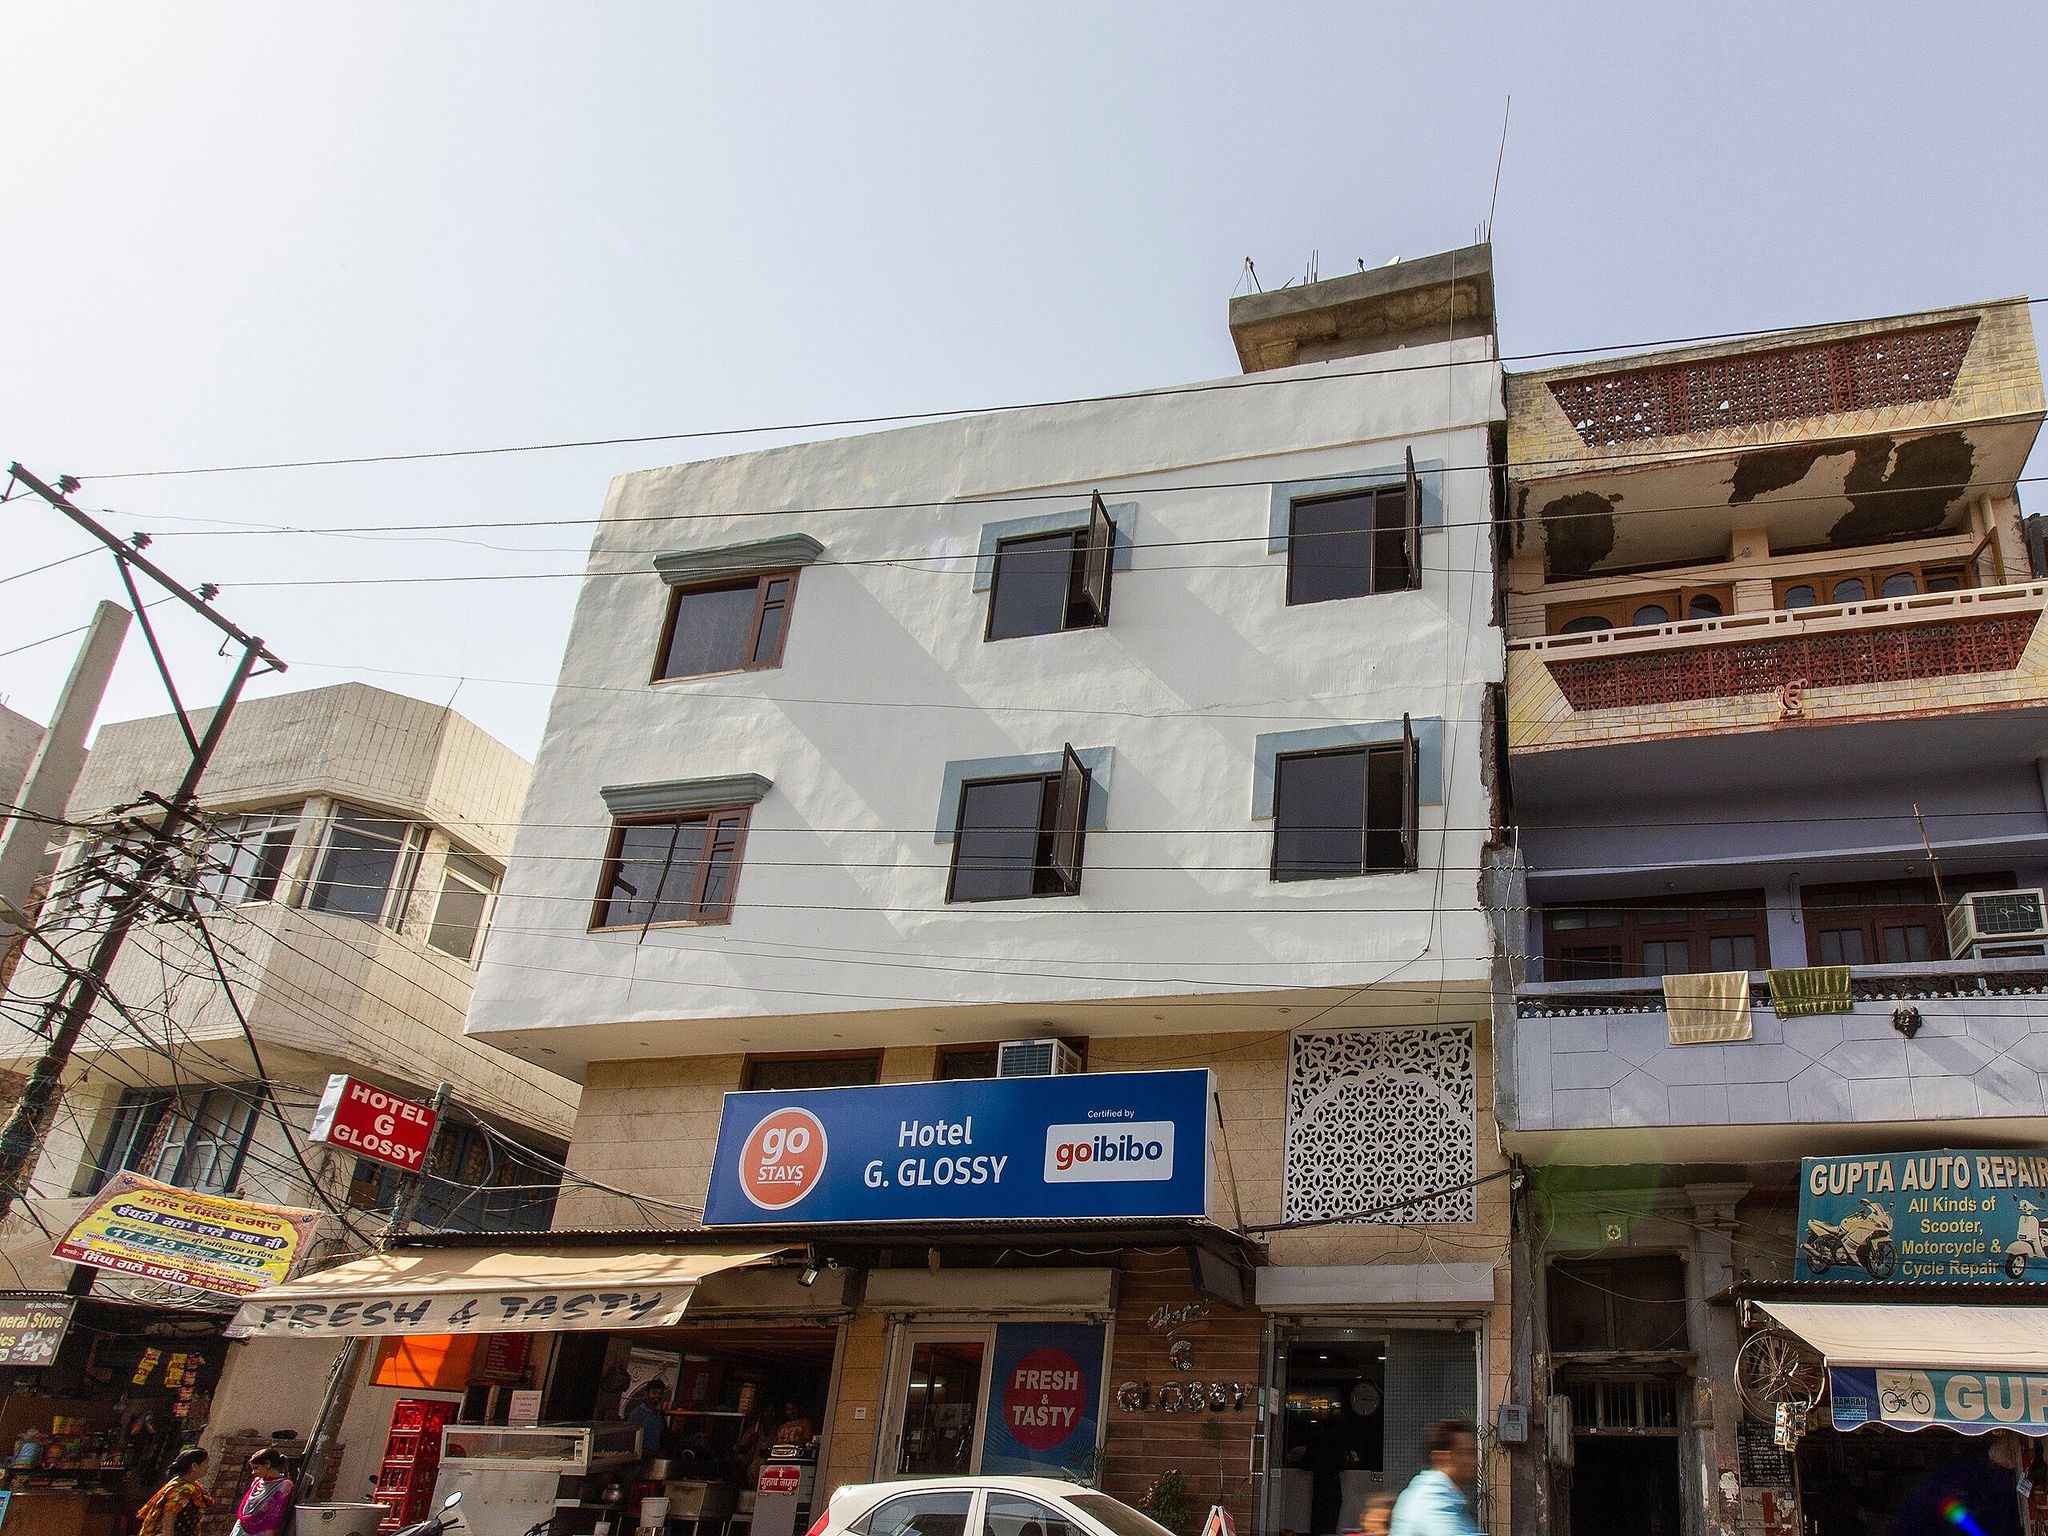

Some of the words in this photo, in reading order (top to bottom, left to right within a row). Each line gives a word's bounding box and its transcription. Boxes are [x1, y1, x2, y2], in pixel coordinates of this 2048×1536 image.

[350, 1085, 429, 1127] HOTEL
[1087, 1109, 1122, 1118] Certified
[1124, 1109, 1135, 1119] by
[374, 1114, 396, 1136] G
[898, 1116, 973, 1148] Hotel
[333, 1124, 422, 1164] GLOSSY
[761, 1126, 810, 1165] go
[1056, 1135, 1163, 1171] goibibo
[758, 1165, 804, 1181] STAYS
[863, 1160, 889, 1188] G.
[897, 1155, 1008, 1187] GLOSSY
[1810, 1160, 1896, 1195] GUPTA
[1901, 1155, 1971, 1191] AUTO
[1976, 1156, 2048, 1189] REPAIR
[1908, 1199, 1928, 1213] All
[1933, 1197, 1976, 1213] Kinds
[1981, 1196, 1996, 1211] of
[1920, 1218, 1983, 1235] Scooter,
[112, 1228, 135, 1239] 17
[155, 1238, 177, 1249] 23
[1902, 1239, 1986, 1258] Motorcycle
[1990, 1240, 2001, 1254] &
[1902, 1260, 1944, 1279] Cycle
[1949, 1260, 1999, 1279] Repair
[30, 1312, 64, 1329] Store
[259, 1299, 433, 1329] FRESH
[500, 1292, 662, 1323] TASTY
[1015, 1370, 1079, 1390] FRESH
[1041, 1393, 1049, 1404] &
[1013, 1405, 1076, 1427] TASTY
